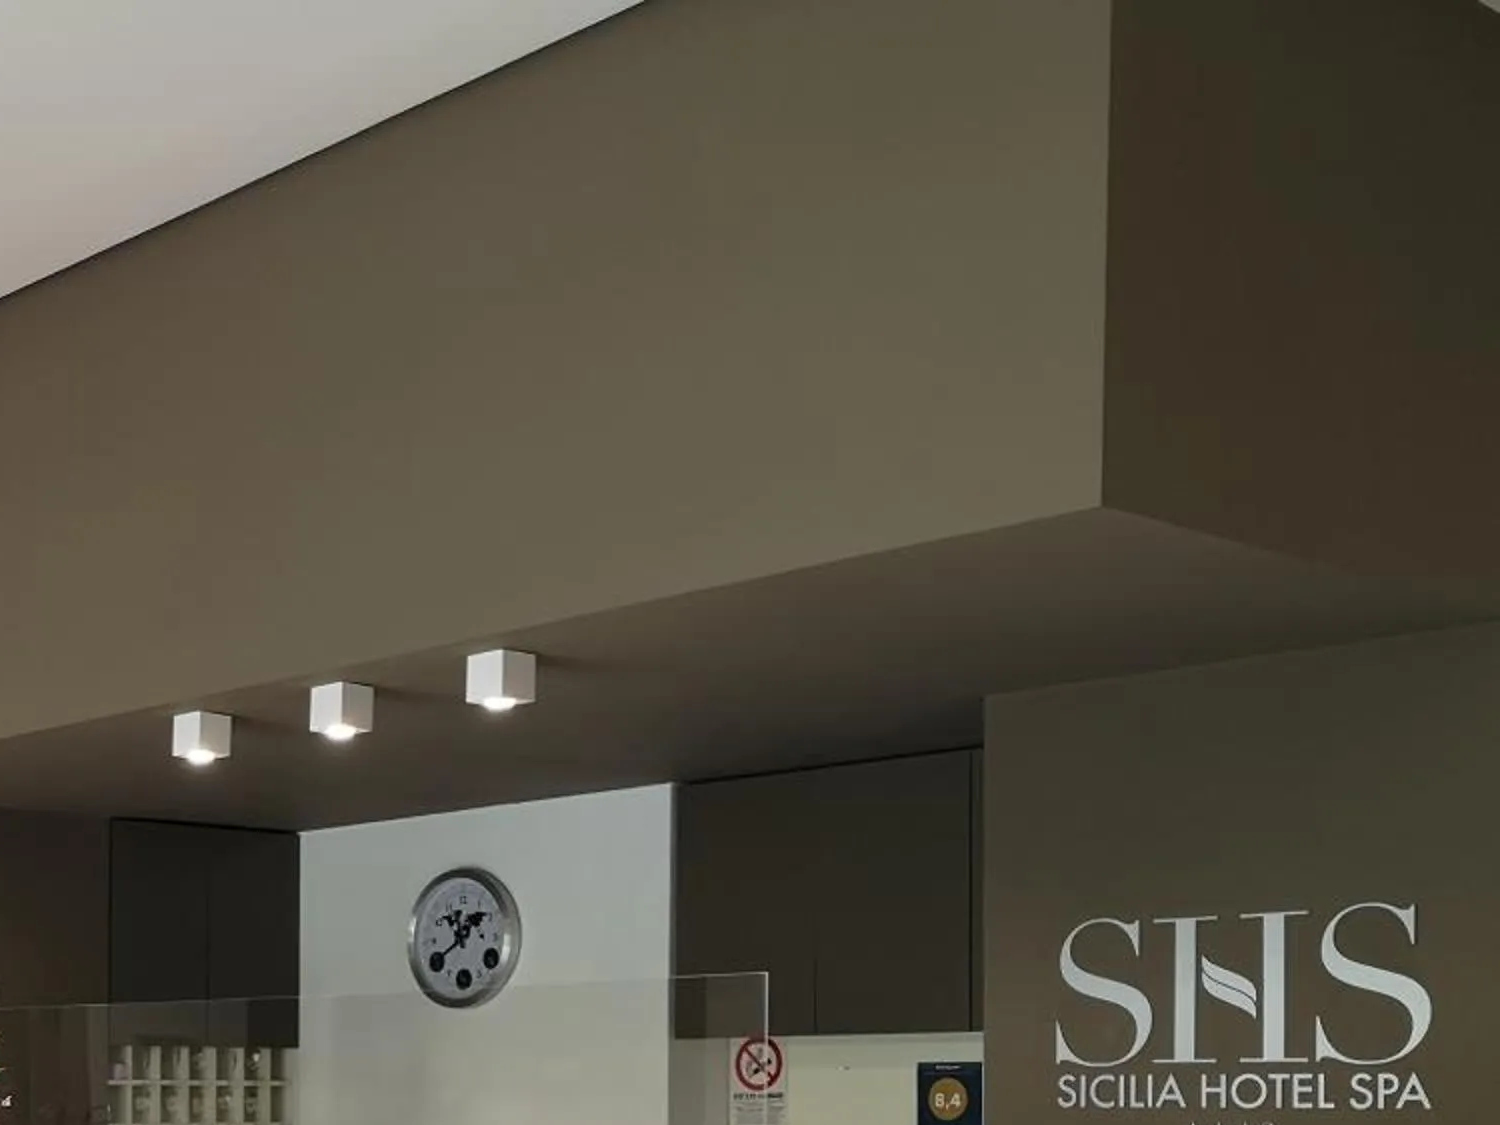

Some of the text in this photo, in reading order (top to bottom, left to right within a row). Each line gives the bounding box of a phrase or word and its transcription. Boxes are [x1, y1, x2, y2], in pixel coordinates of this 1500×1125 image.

[1055, 902, 1433, 1067] SHS
[1056, 1071, 1433, 1111] SICILIA HOTEL SPA
